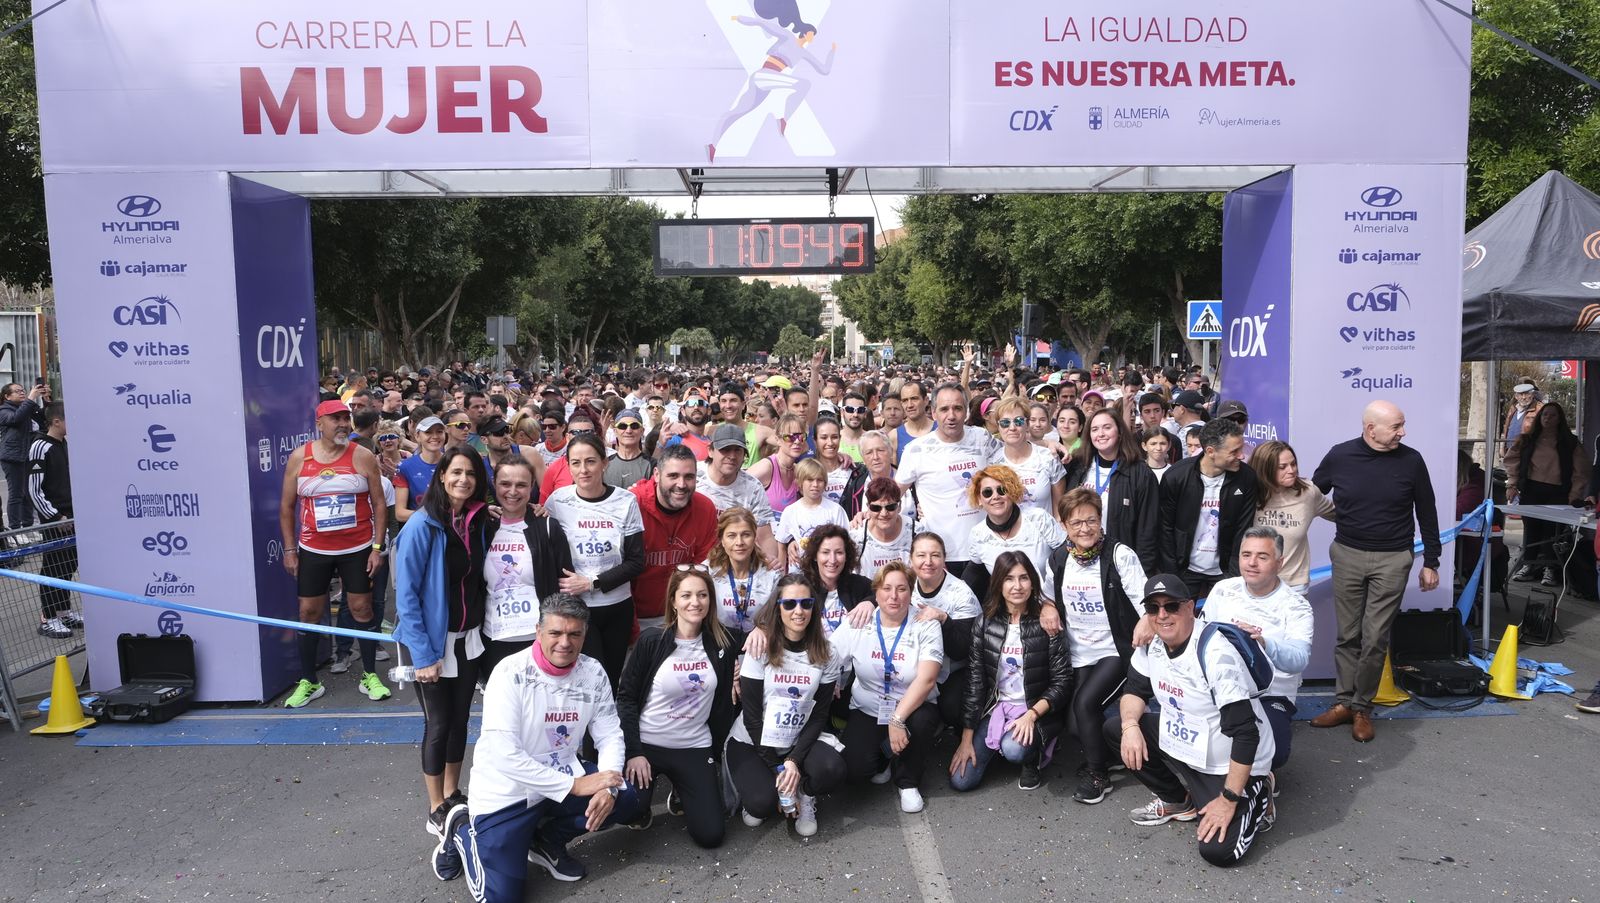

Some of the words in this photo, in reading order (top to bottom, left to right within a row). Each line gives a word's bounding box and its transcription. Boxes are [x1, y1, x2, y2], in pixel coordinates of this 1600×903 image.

[255, 20, 418, 49] CARRERA
[429, 19, 473, 48] DE
[486, 19, 527, 48] LA
[1043, 17, 1081, 43] LA
[1091, 16, 1248, 43] IGUALDAD
[994, 61, 1034, 88] ES
[1042, 61, 1193, 88] NUESTRA
[1199, 61, 1296, 87] META.
[239, 65, 548, 136] MUJER
[1114, 106, 1170, 120] ALMERÍA
[1344, 211, 1418, 221] HYUNDAI
[102, 221, 180, 232] HYUNDAI
[1353, 224, 1409, 233] Almerialva
[113, 235, 173, 245] Almerialva
[1361, 249, 1421, 265] cajamar
[125, 261, 188, 277] cajamar
[1346, 291, 1399, 312] CASI
[113, 304, 168, 326] CASI
[1362, 327, 1416, 342] vithas
[133, 342, 190, 357] vithas
[1351, 373, 1413, 392] aqualia
[126, 389, 192, 409] aqualia
[1243, 422, 1278, 442] LMERÍA
[137, 459, 179, 471] Clece
[948, 461, 977, 472] MUJER
[142, 506, 166, 517] PIEDRA
[164, 493, 200, 517] CASH
[327, 504, 343, 515] 77
[578, 520, 614, 529] MUJER
[142, 531, 188, 556] ego
[489, 543, 525, 553] MUJER
[576, 541, 613, 555] 1363
[144, 582, 195, 597] Lanjarón
[496, 600, 532, 617] 1360
[1070, 601, 1105, 613] 1365
[673, 661, 708, 671] MUJER
[774, 674, 811, 685] MUJER
[1158, 680, 1184, 698] MUJER
[544, 712, 579, 722] MUJER
[774, 712, 806, 726] 1362
[1165, 720, 1199, 743] 1367
